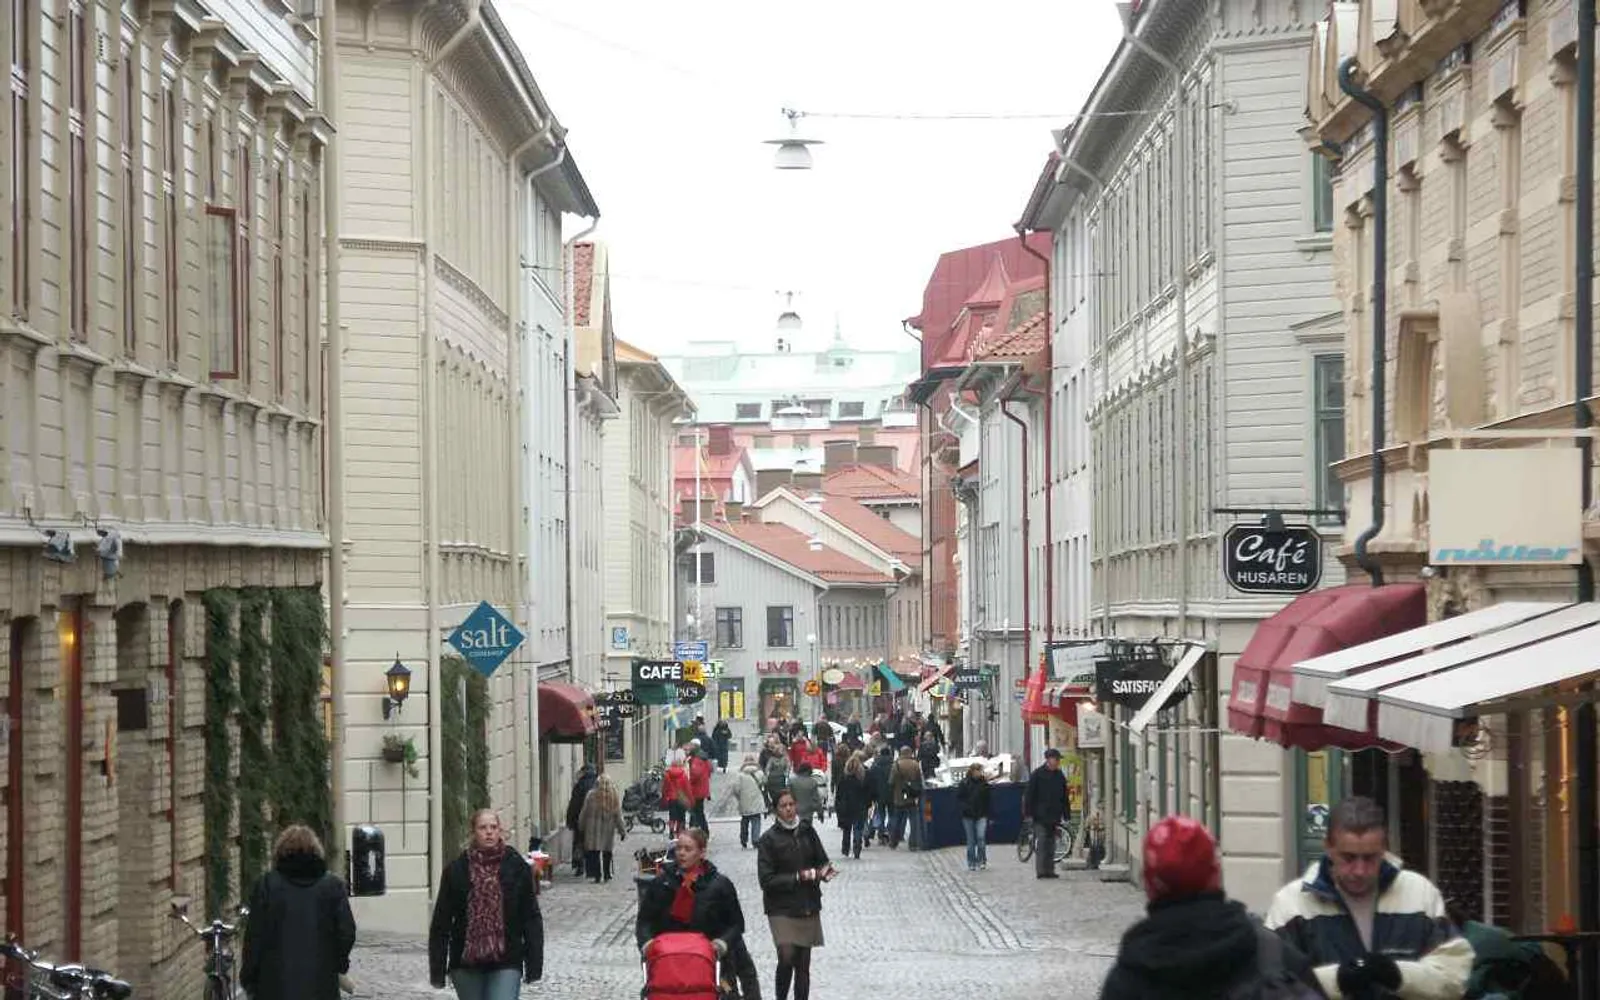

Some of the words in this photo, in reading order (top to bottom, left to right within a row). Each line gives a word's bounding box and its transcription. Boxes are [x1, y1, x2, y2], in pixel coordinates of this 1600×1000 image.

[1236, 534, 1309, 571] Café
[1237, 571, 1308, 584] HUSAREN
[460, 616, 512, 649] salt
[640, 662, 681, 679] CAFÉ
[756, 660, 800, 674] LIVS
